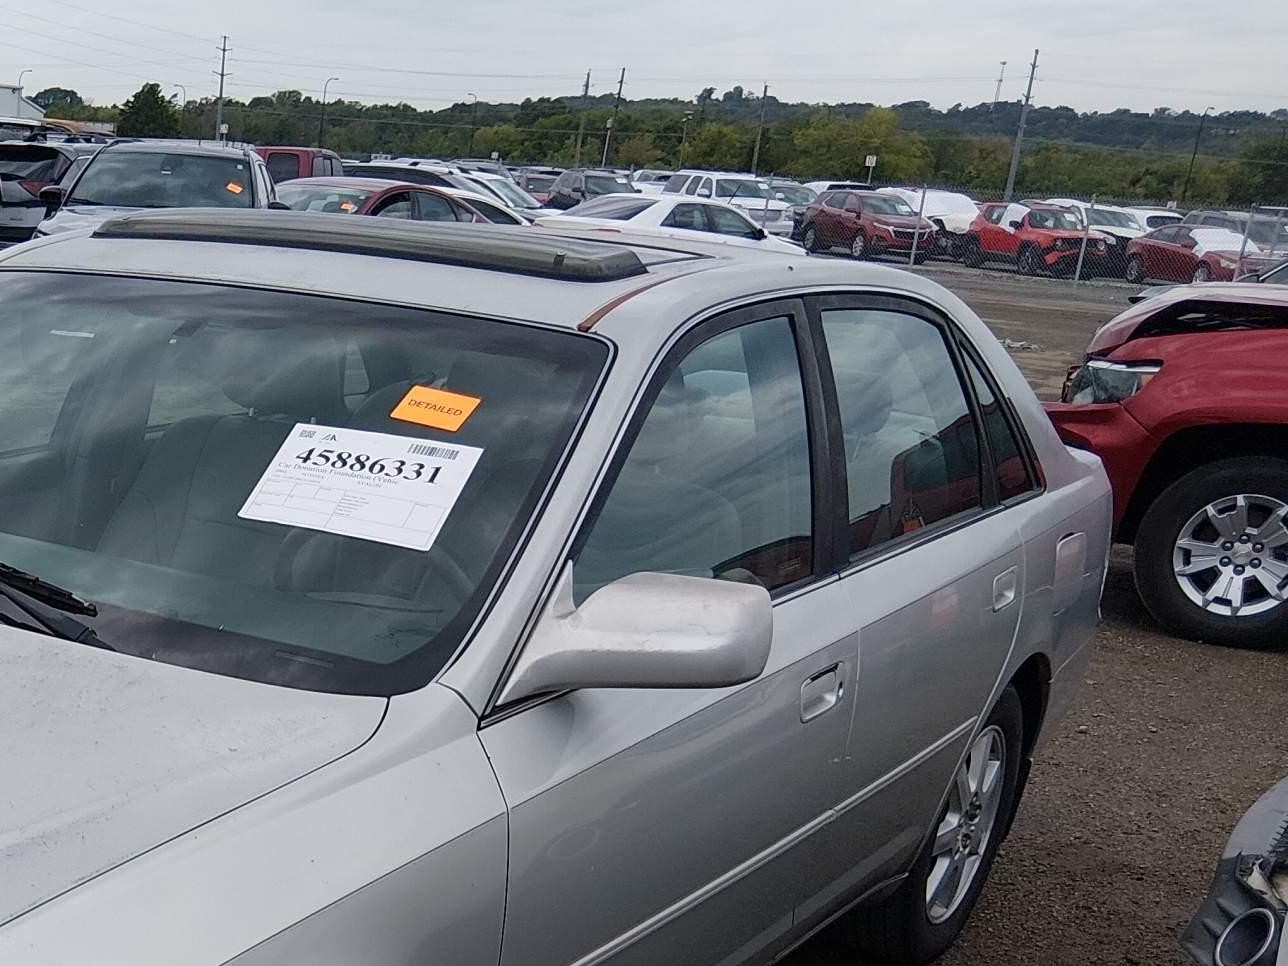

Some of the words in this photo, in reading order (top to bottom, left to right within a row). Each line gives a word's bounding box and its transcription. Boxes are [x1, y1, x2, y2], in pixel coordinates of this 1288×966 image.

[408, 399, 463, 416] DETAILED
[293, 463, 327, 474] Donation
[329, 469, 372, 481] Foundation
[295, 447, 443, 485] 45886331
